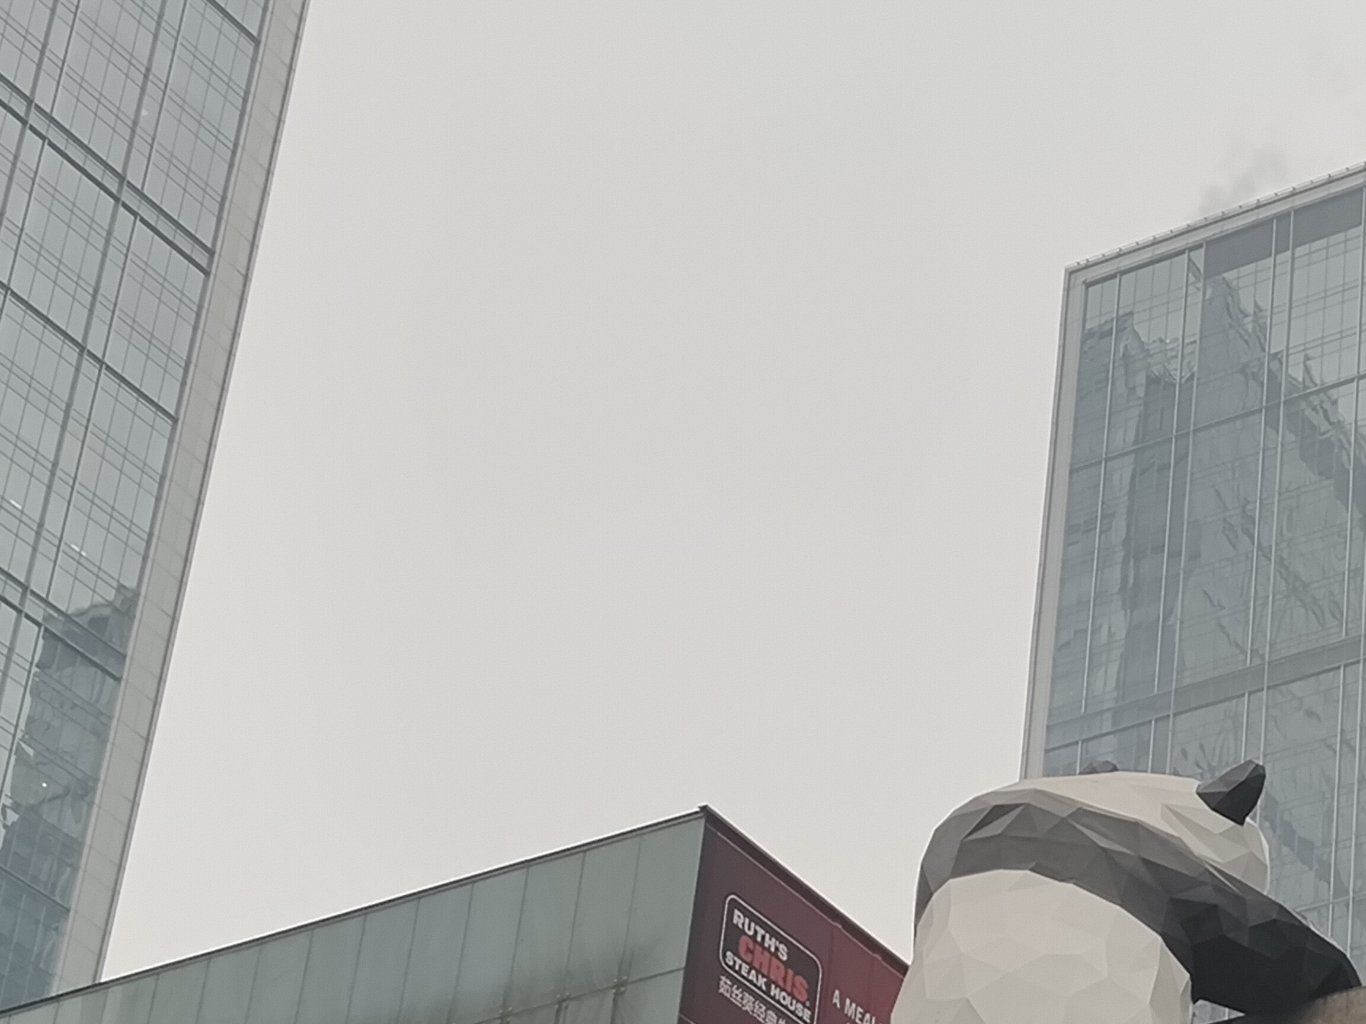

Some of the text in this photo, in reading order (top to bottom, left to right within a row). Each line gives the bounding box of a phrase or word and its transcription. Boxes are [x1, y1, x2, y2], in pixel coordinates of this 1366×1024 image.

[733, 908, 788, 960] RUTH'S
[724, 951, 811, 1023] STEAK HOUSE
[738, 935, 808, 1002] CHRIS
[832, 989, 840, 1009] A
